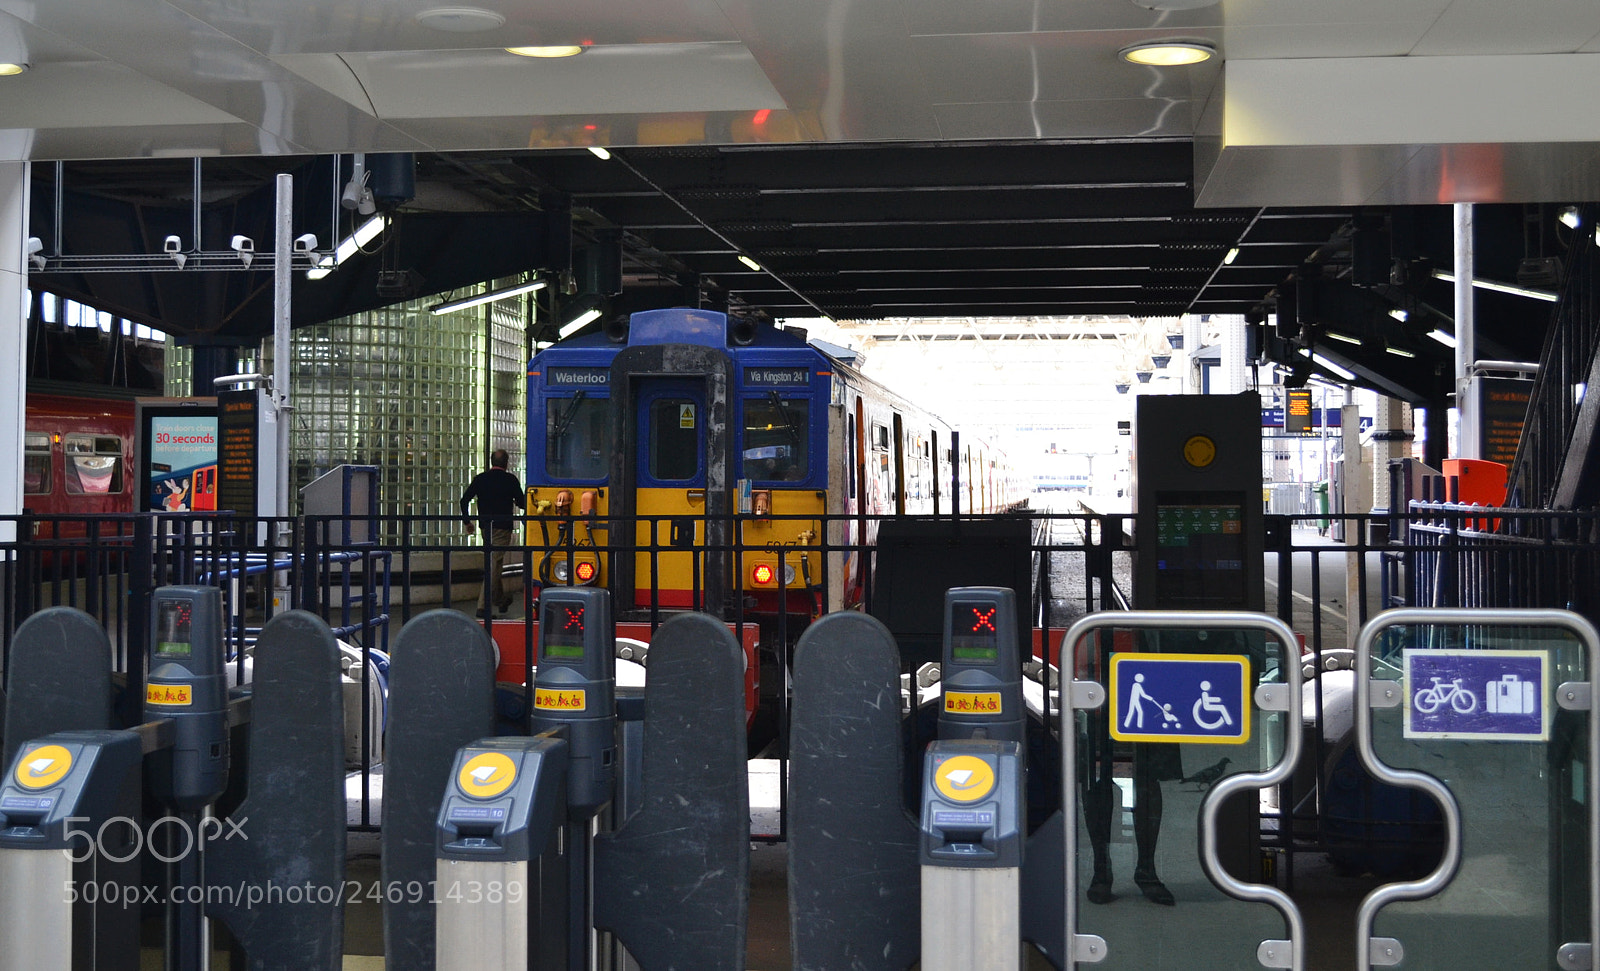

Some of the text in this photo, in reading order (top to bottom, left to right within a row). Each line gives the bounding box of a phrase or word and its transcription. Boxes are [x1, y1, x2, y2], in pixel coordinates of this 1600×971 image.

[555, 371, 606, 384] Waterloo
[751, 371, 803, 385] Via Kingston 24
[155, 423, 215, 432] Train doors close
[155, 432, 215, 444] 30 seconds
[155, 444, 217, 455] before departure
